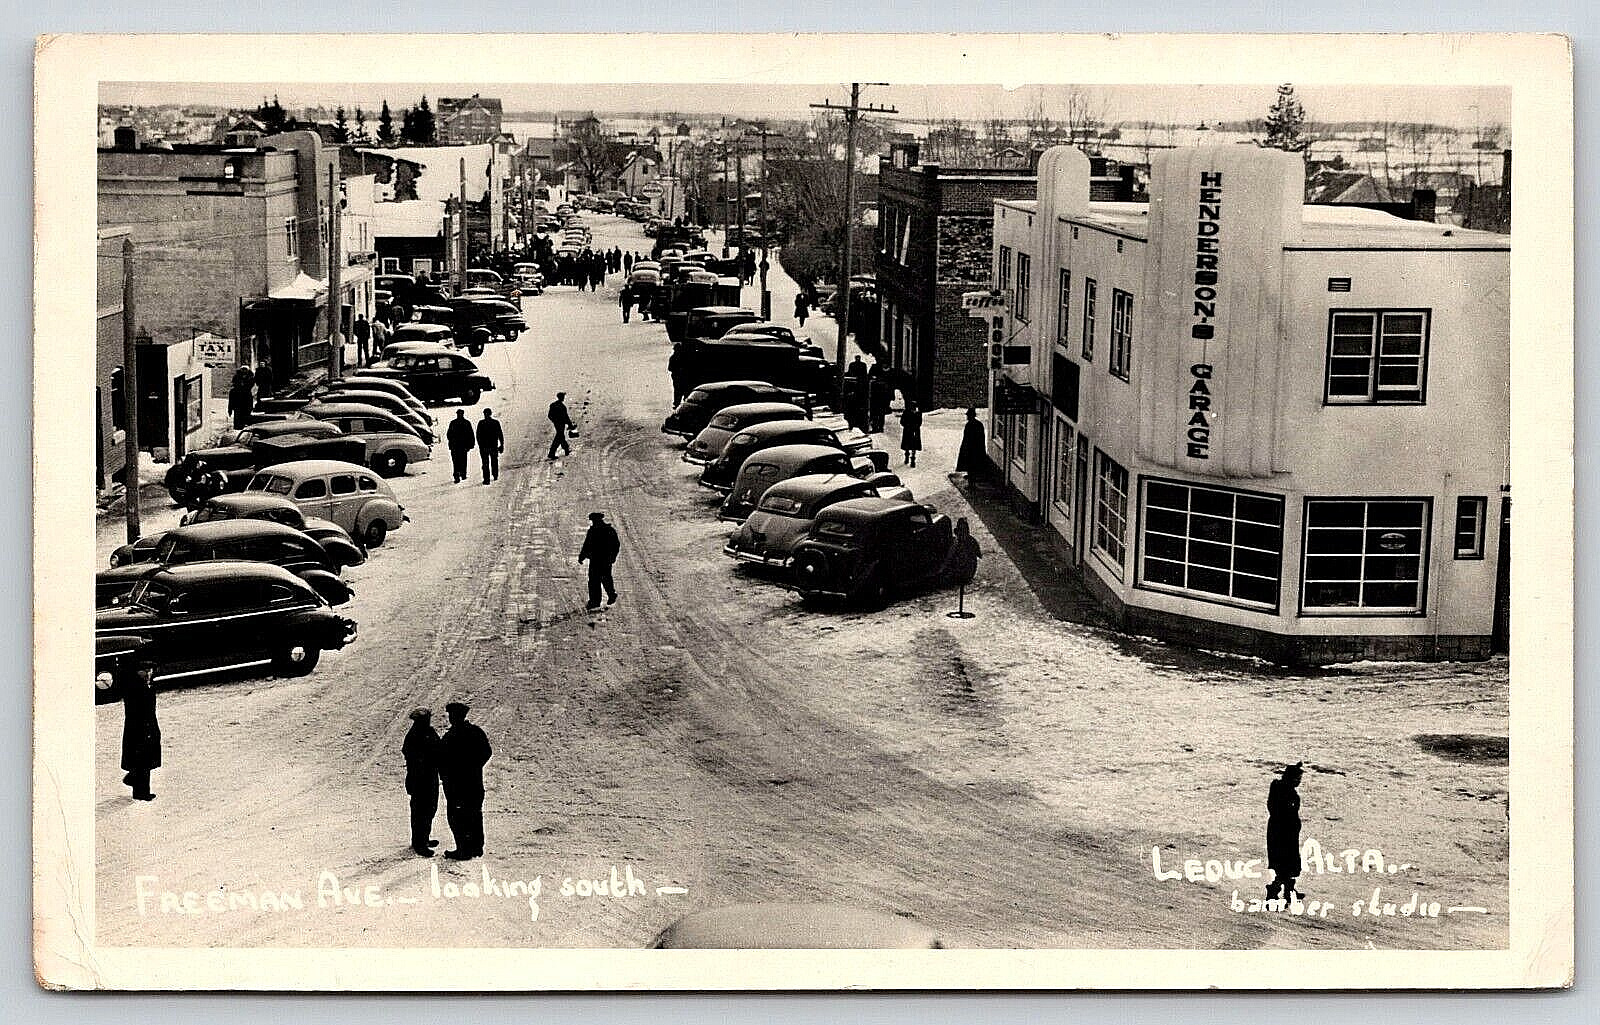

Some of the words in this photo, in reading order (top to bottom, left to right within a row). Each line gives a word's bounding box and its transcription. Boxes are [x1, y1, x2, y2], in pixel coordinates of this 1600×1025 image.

[1192, 171, 1222, 339] HENDERSON'S
[199, 344, 231, 352] TAXI
[1187, 364, 1213, 459] GARAGE
